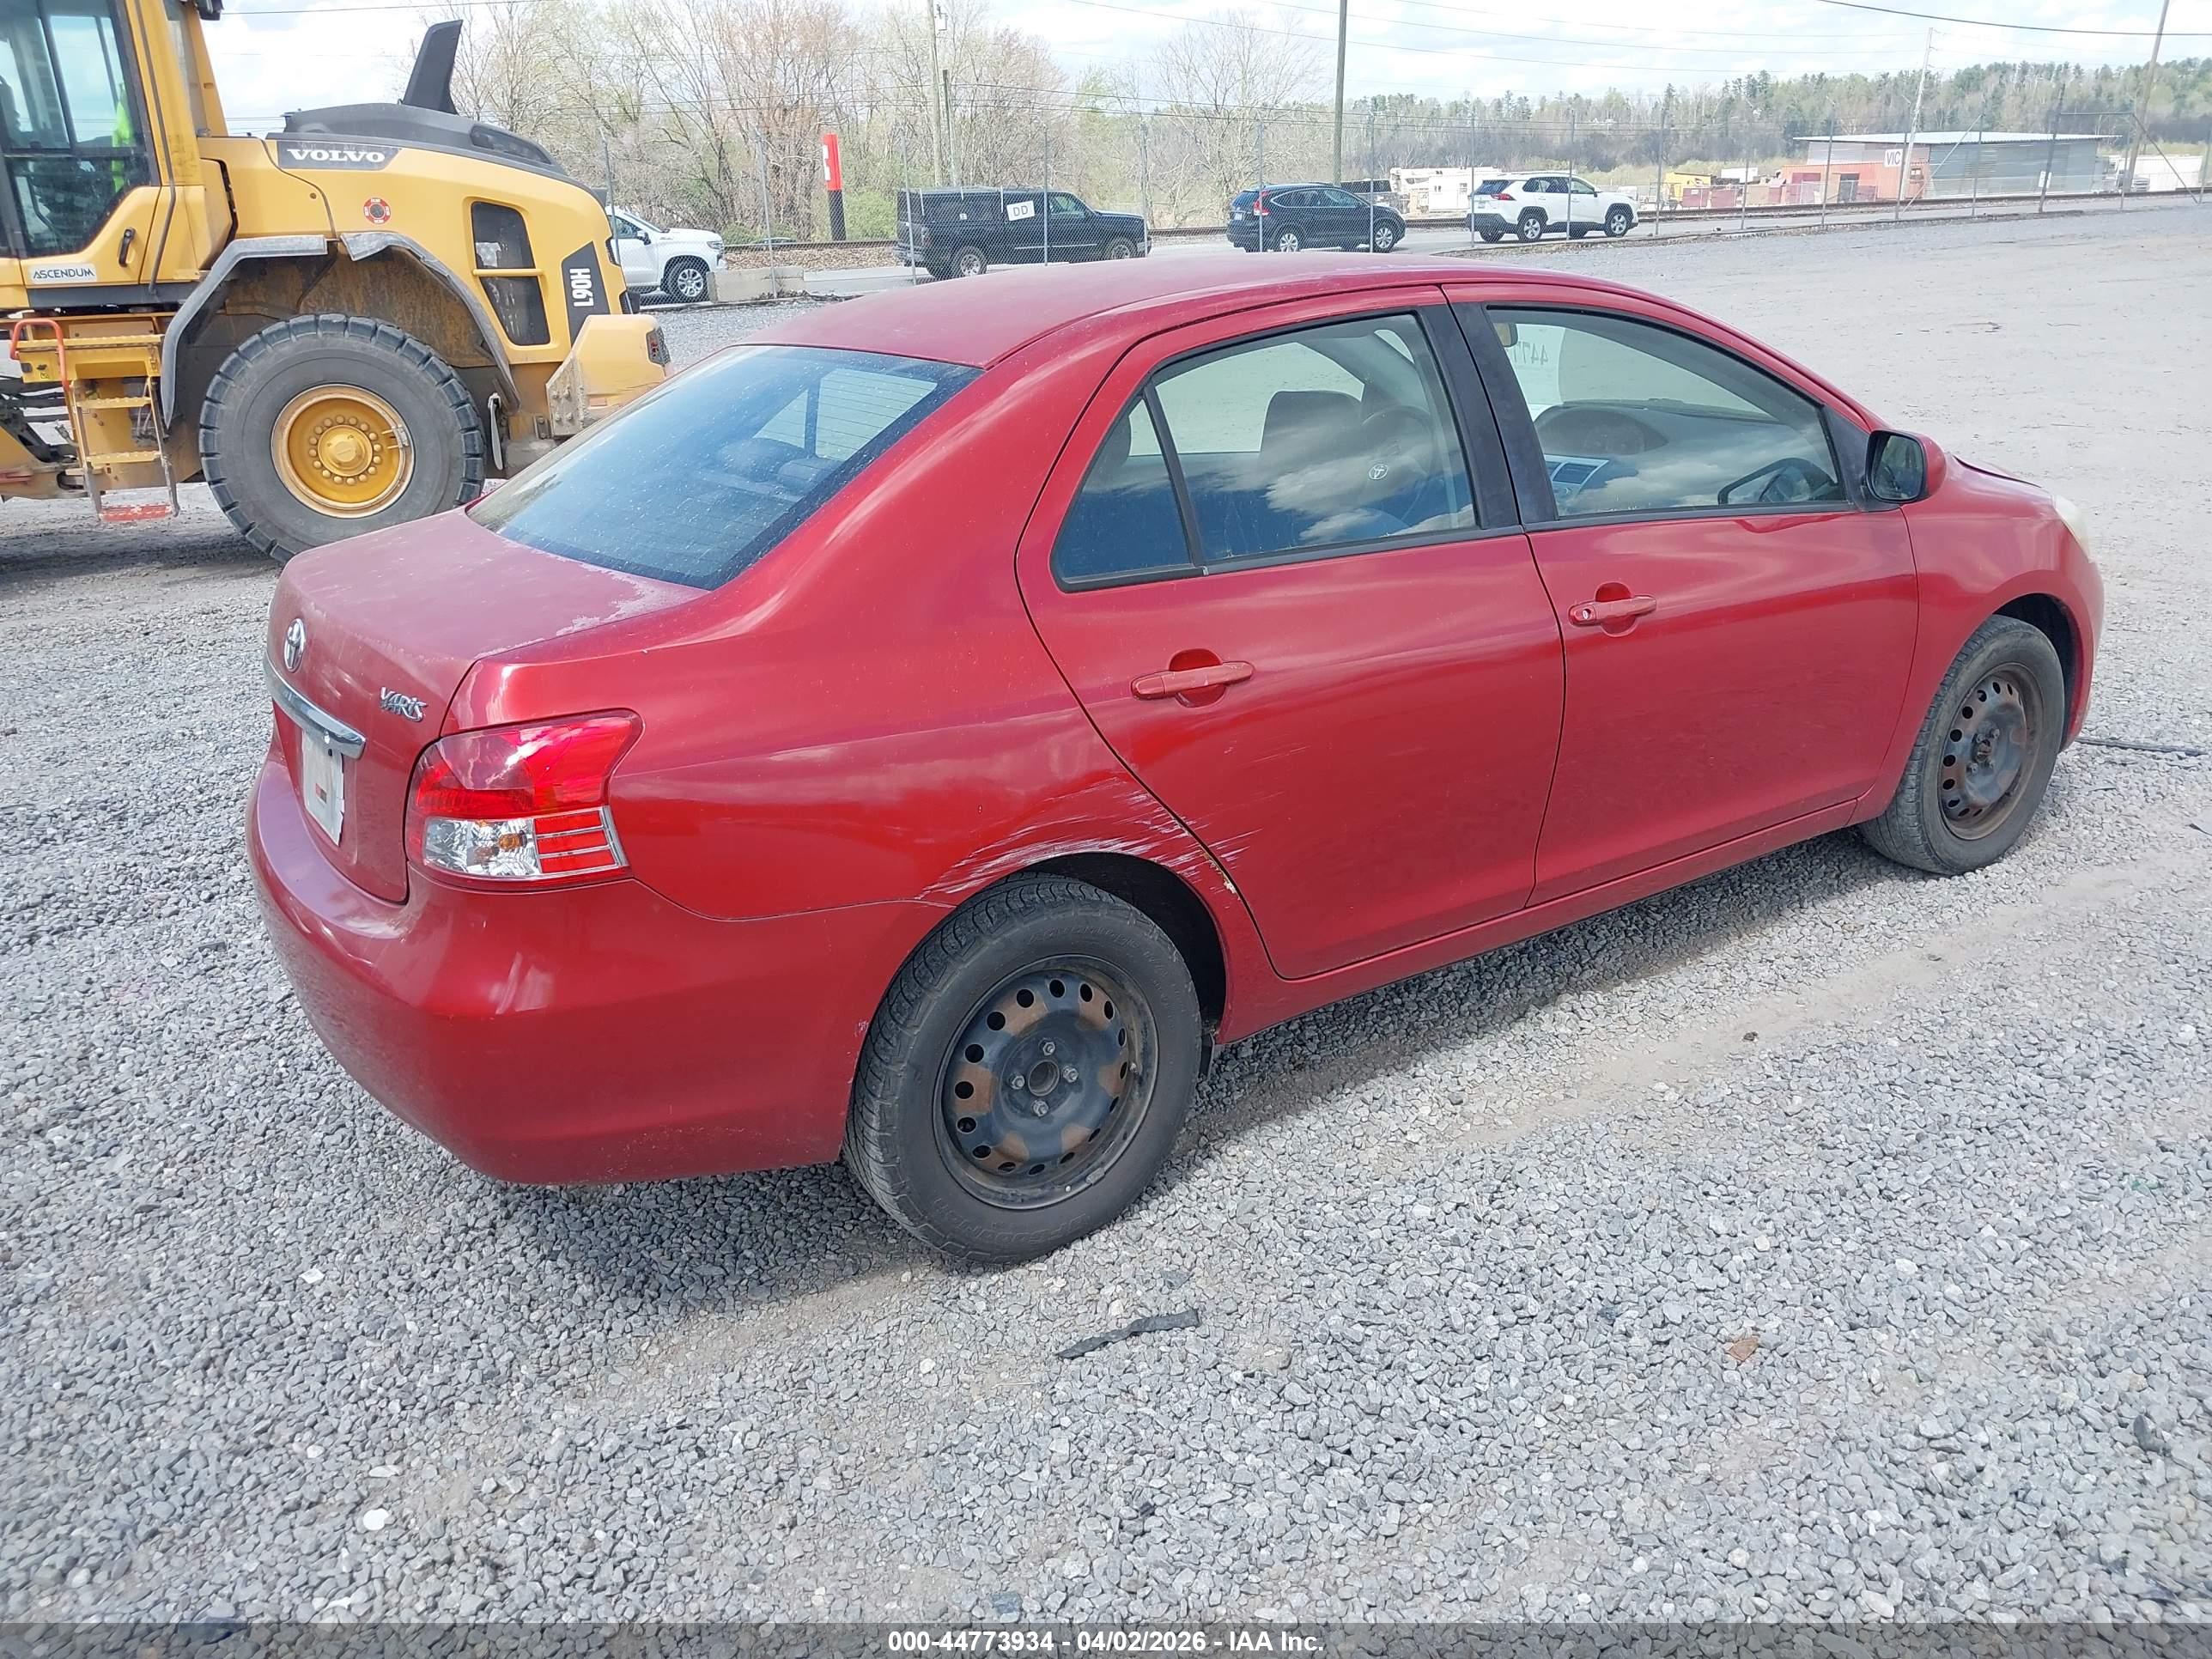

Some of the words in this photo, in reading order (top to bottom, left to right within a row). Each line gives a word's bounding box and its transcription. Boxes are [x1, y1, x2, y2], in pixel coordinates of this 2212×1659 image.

[287, 149, 386, 163] VOLVO
[1012, 205, 1029, 216] DD
[33, 268, 94, 279] ASCENDUM
[569, 268, 594, 307] L90H
